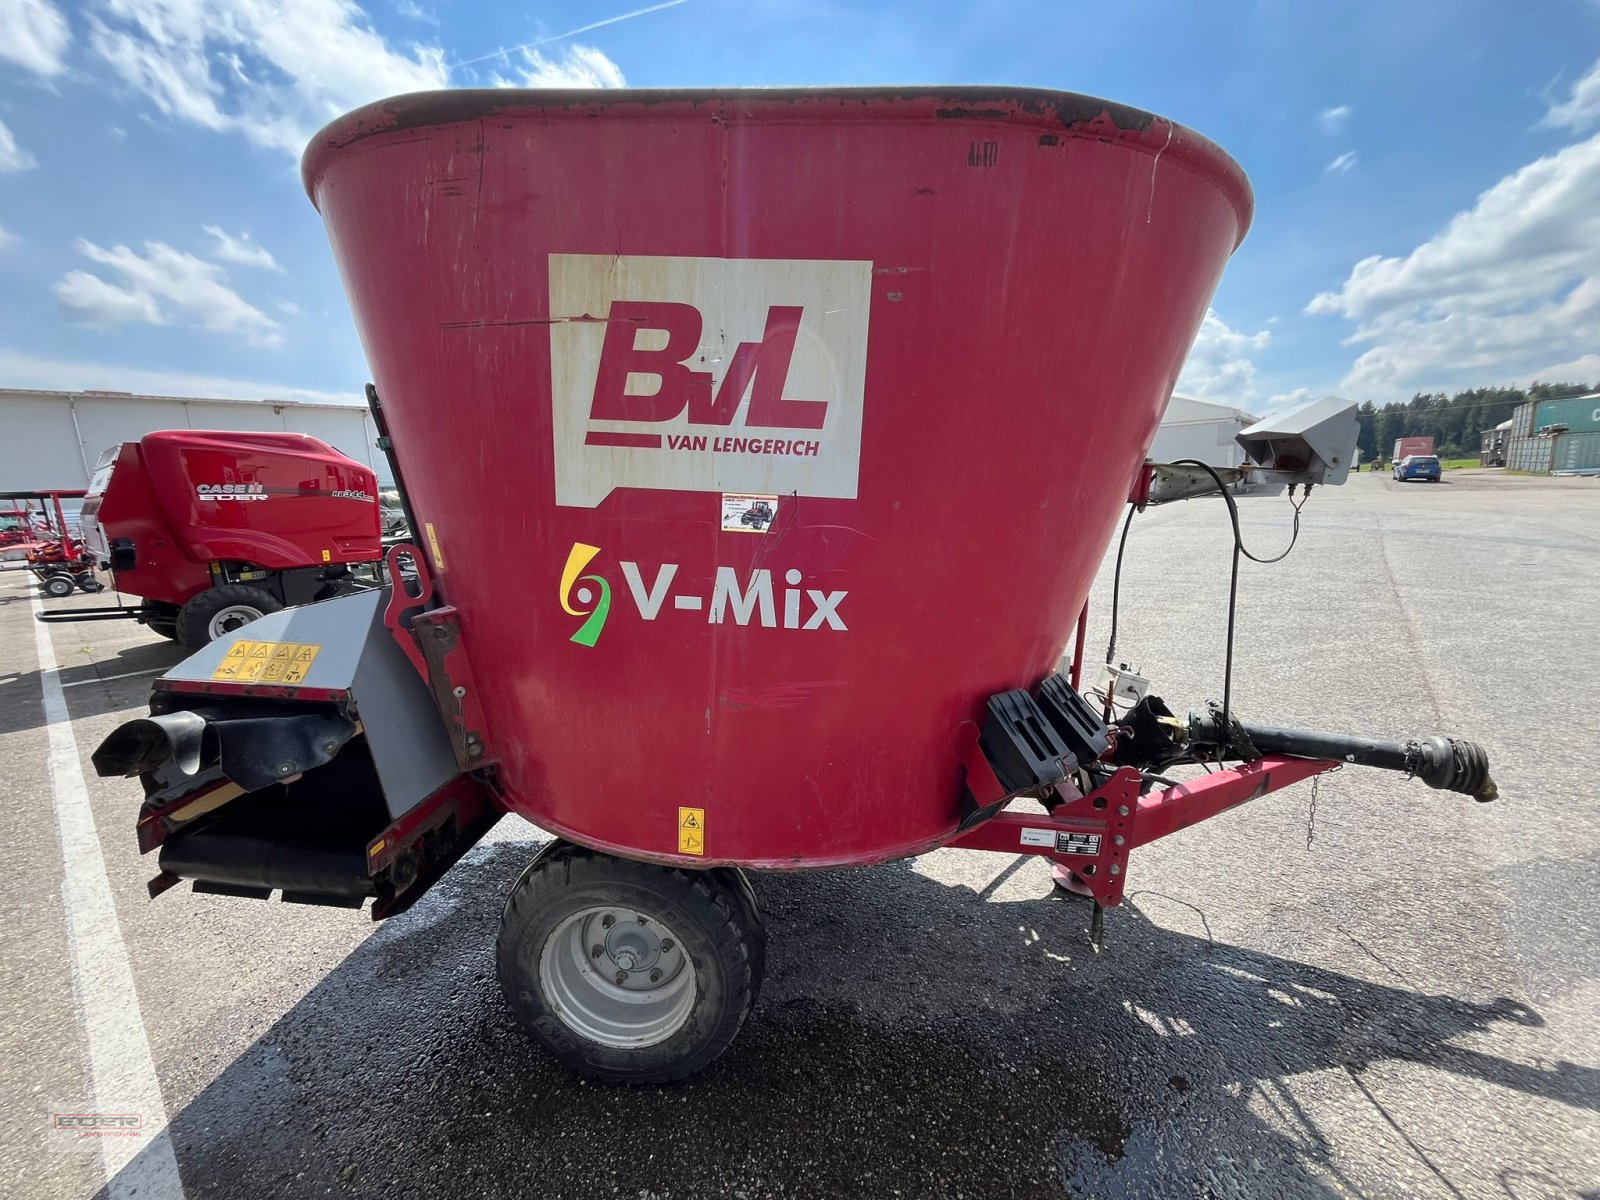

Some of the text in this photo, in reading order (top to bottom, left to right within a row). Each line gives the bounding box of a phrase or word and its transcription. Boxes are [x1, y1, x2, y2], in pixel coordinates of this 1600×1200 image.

[667, 434, 820, 457] VAN LENGERICH
[197, 484, 246, 493] CASE
[619, 561, 849, 631] V-Mix
